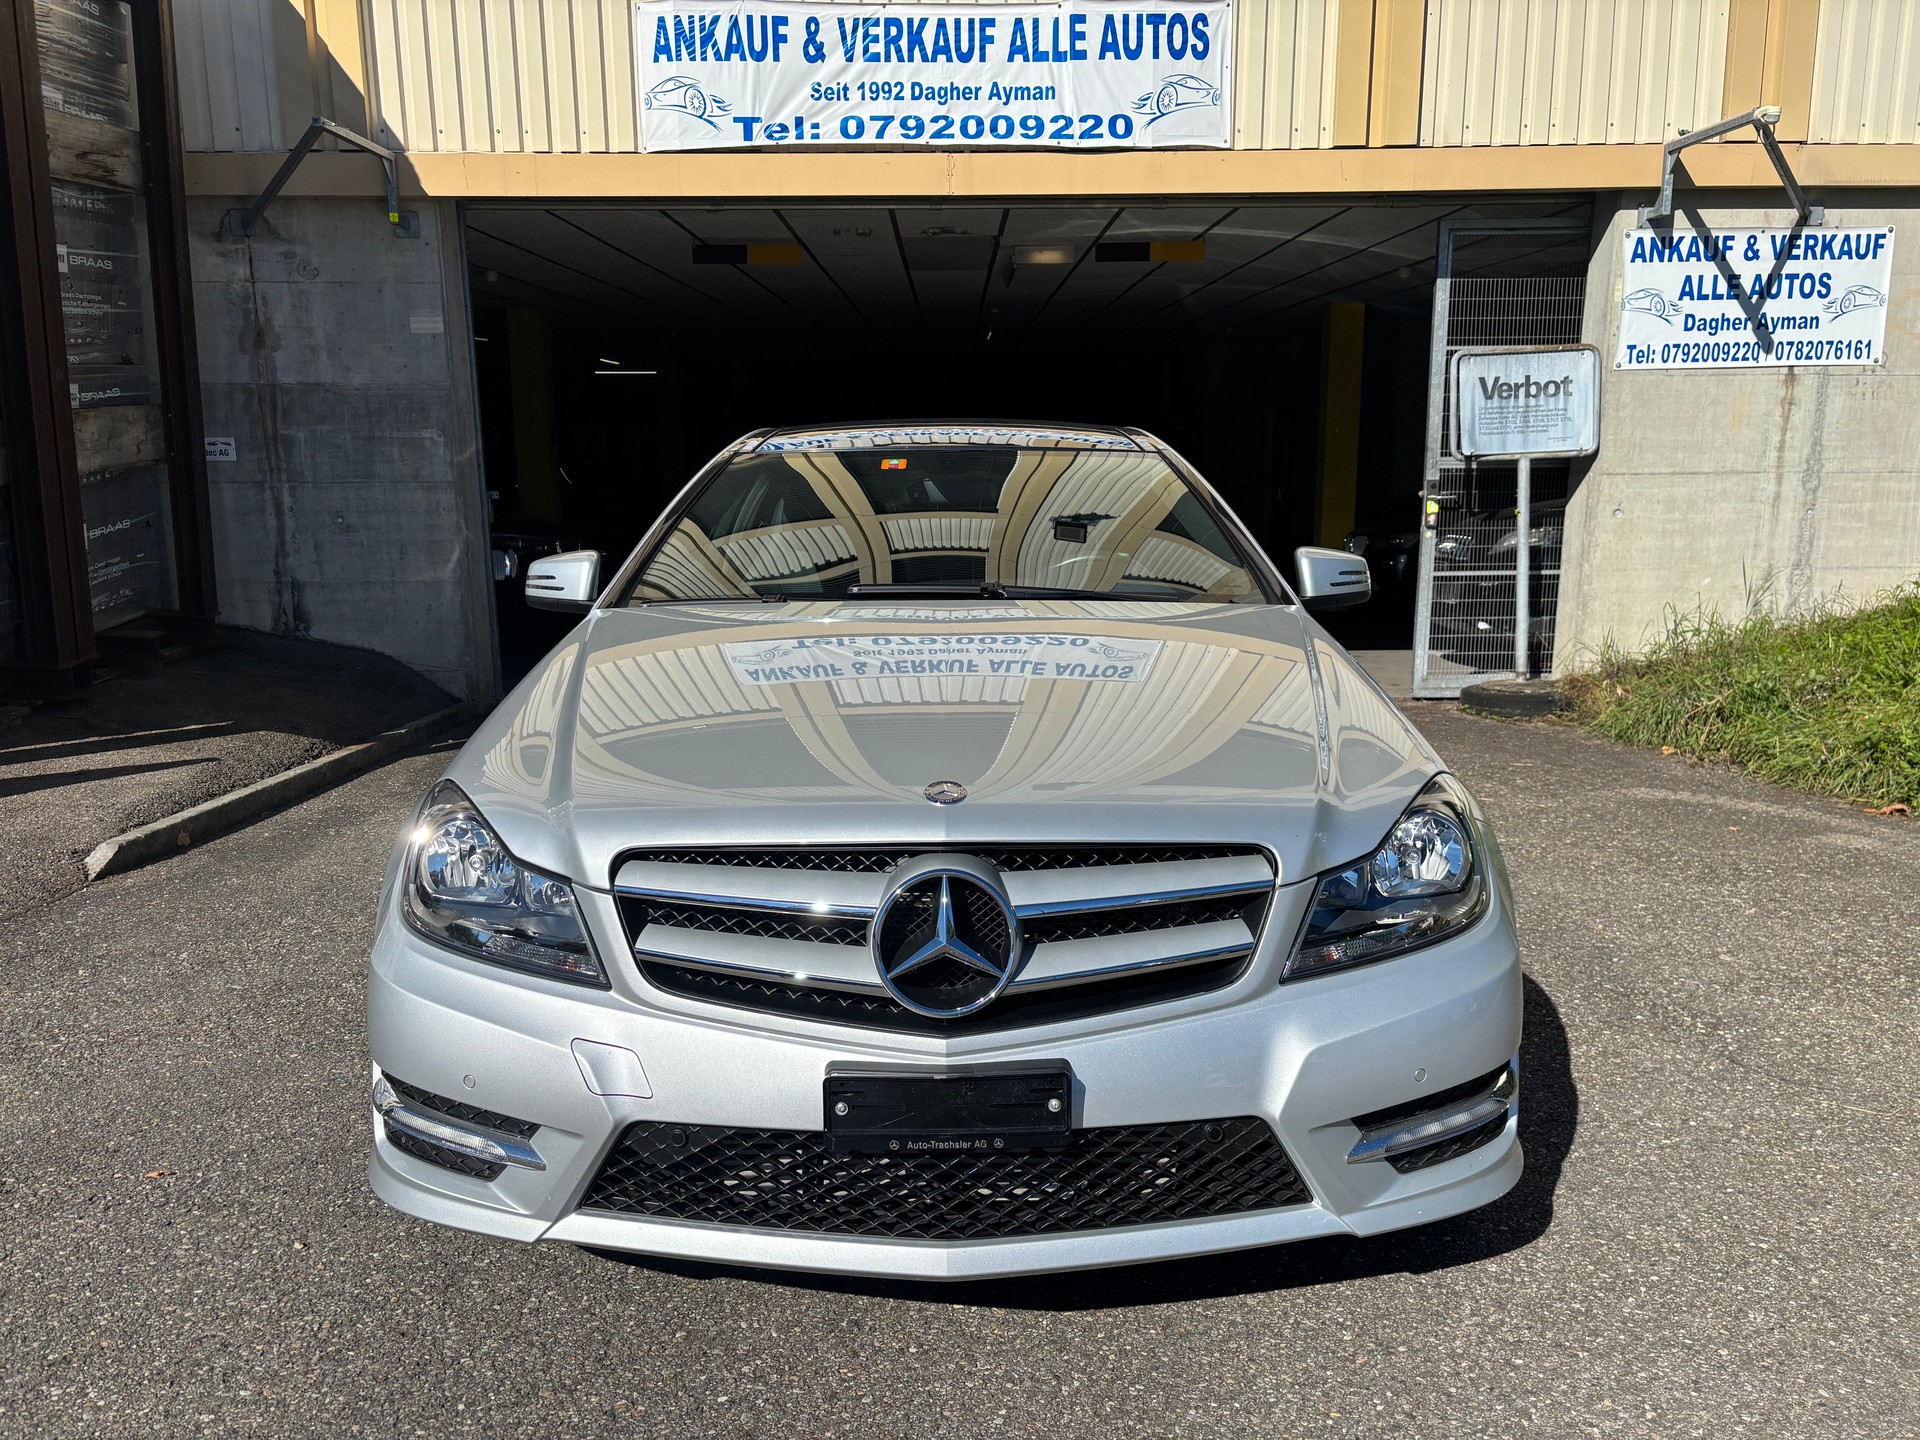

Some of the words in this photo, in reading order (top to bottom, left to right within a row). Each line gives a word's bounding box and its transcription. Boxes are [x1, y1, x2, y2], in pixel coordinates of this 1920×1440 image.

[652, 15, 789, 64] ANKAUF
[803, 15, 826, 65] &
[837, 16, 997, 64] VERKAUF
[1008, 14, 1087, 63] ALLE
[1098, 13, 1211, 62] AUTOS
[810, 82, 850, 102] Seit
[857, 82, 905, 102] 1992
[910, 82, 982, 107] Dagher
[988, 82, 1056, 107] Ayman
[733, 116, 821, 142] Tel:
[839, 114, 1134, 141] 0792009220
[1630, 235, 1736, 264] ANKAUF
[1743, 235, 1761, 262] &
[1770, 233, 1887, 262] VERKAUF
[69, 255, 113, 270] BRAAS
[1678, 273, 1742, 302] ALLE
[1749, 272, 1833, 300] AUTOS
[1683, 313, 1751, 336] Dagher
[1756, 312, 1820, 335] Ayman
[1627, 344, 1655, 364] Tel:
[1661, 341, 1760, 364] 0792009220
[1775, 339, 1872, 361] 0782076161
[1478, 375, 1573, 400] Verbot
[89, 519, 131, 539] BRAAS
[975, 1140, 987, 1149] AG
